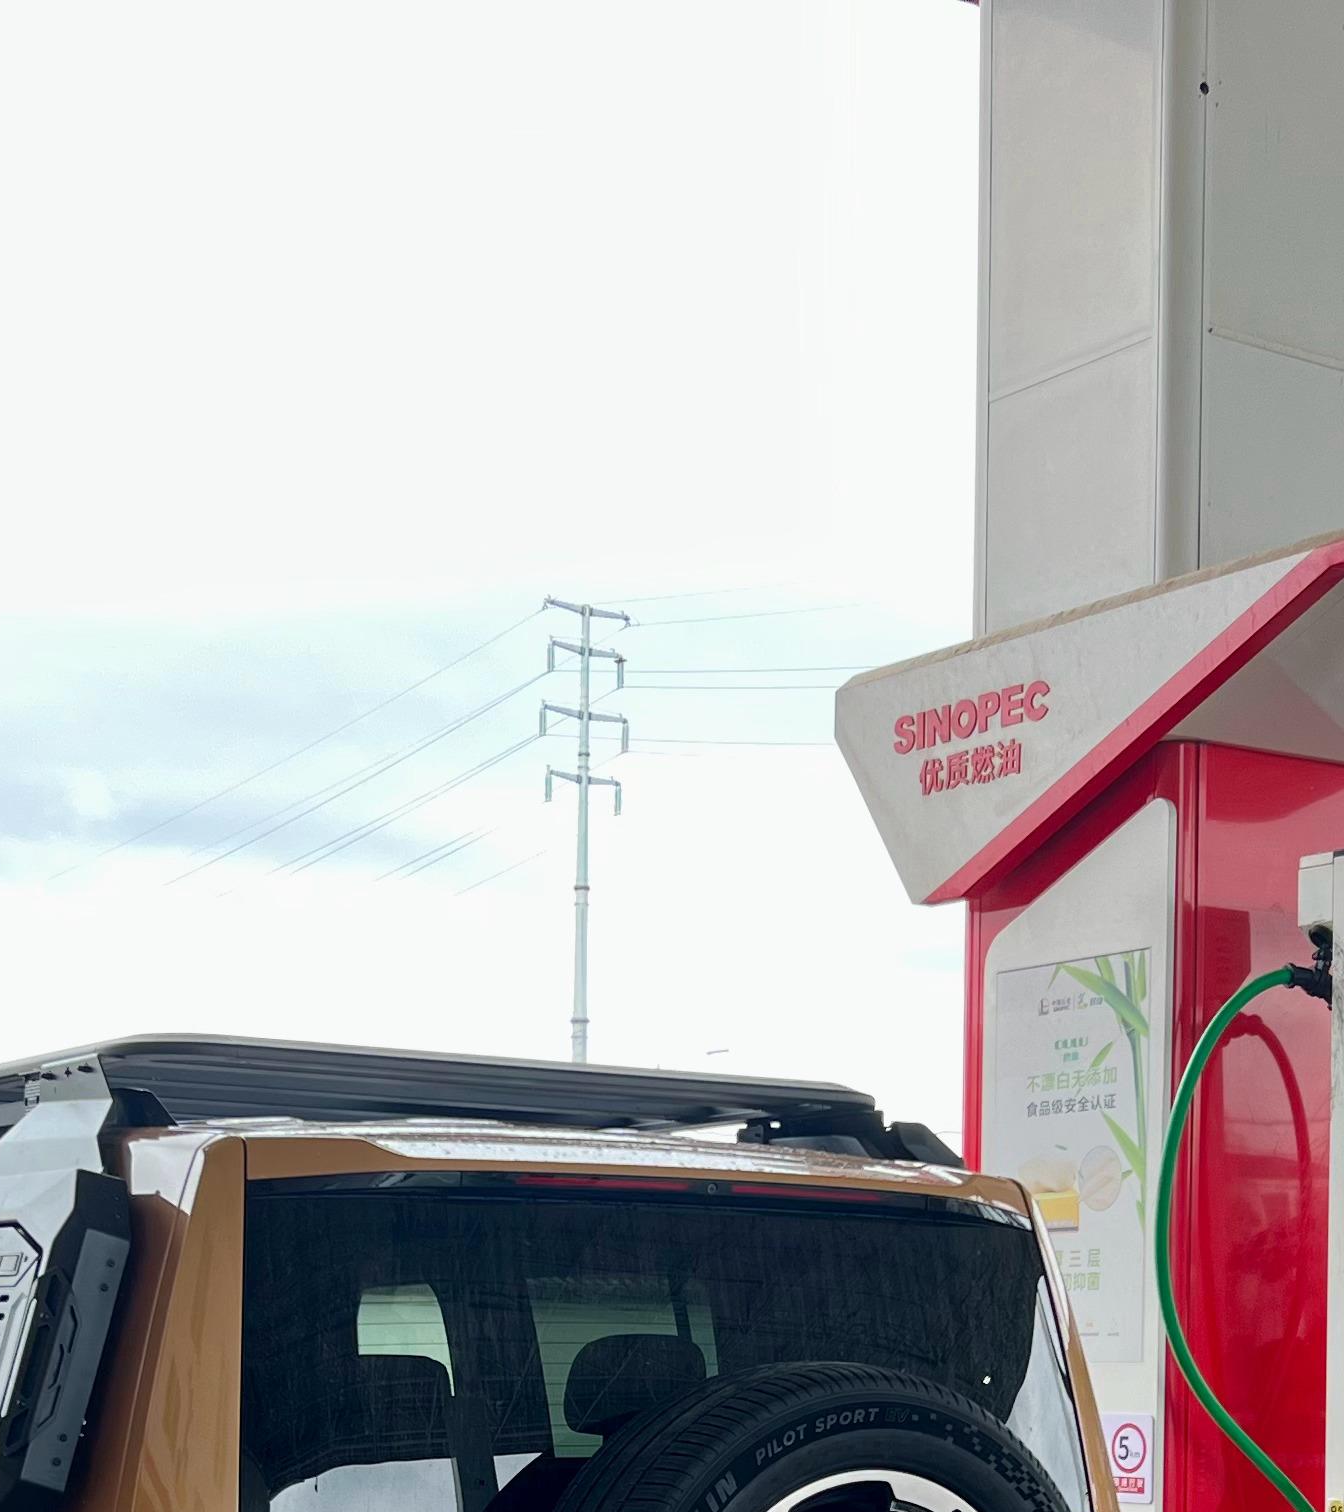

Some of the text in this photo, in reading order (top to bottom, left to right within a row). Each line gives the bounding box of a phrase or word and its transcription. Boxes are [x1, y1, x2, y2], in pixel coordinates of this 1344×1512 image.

[893, 680, 1051, 755] SINOPEC
[919, 738, 1022, 796] 优质燃油
[1026, 1093, 1117, 1118] 食品级安全认证
[756, 1423, 807, 1466] PILOT
[814, 1407, 879, 1434] SPORT
